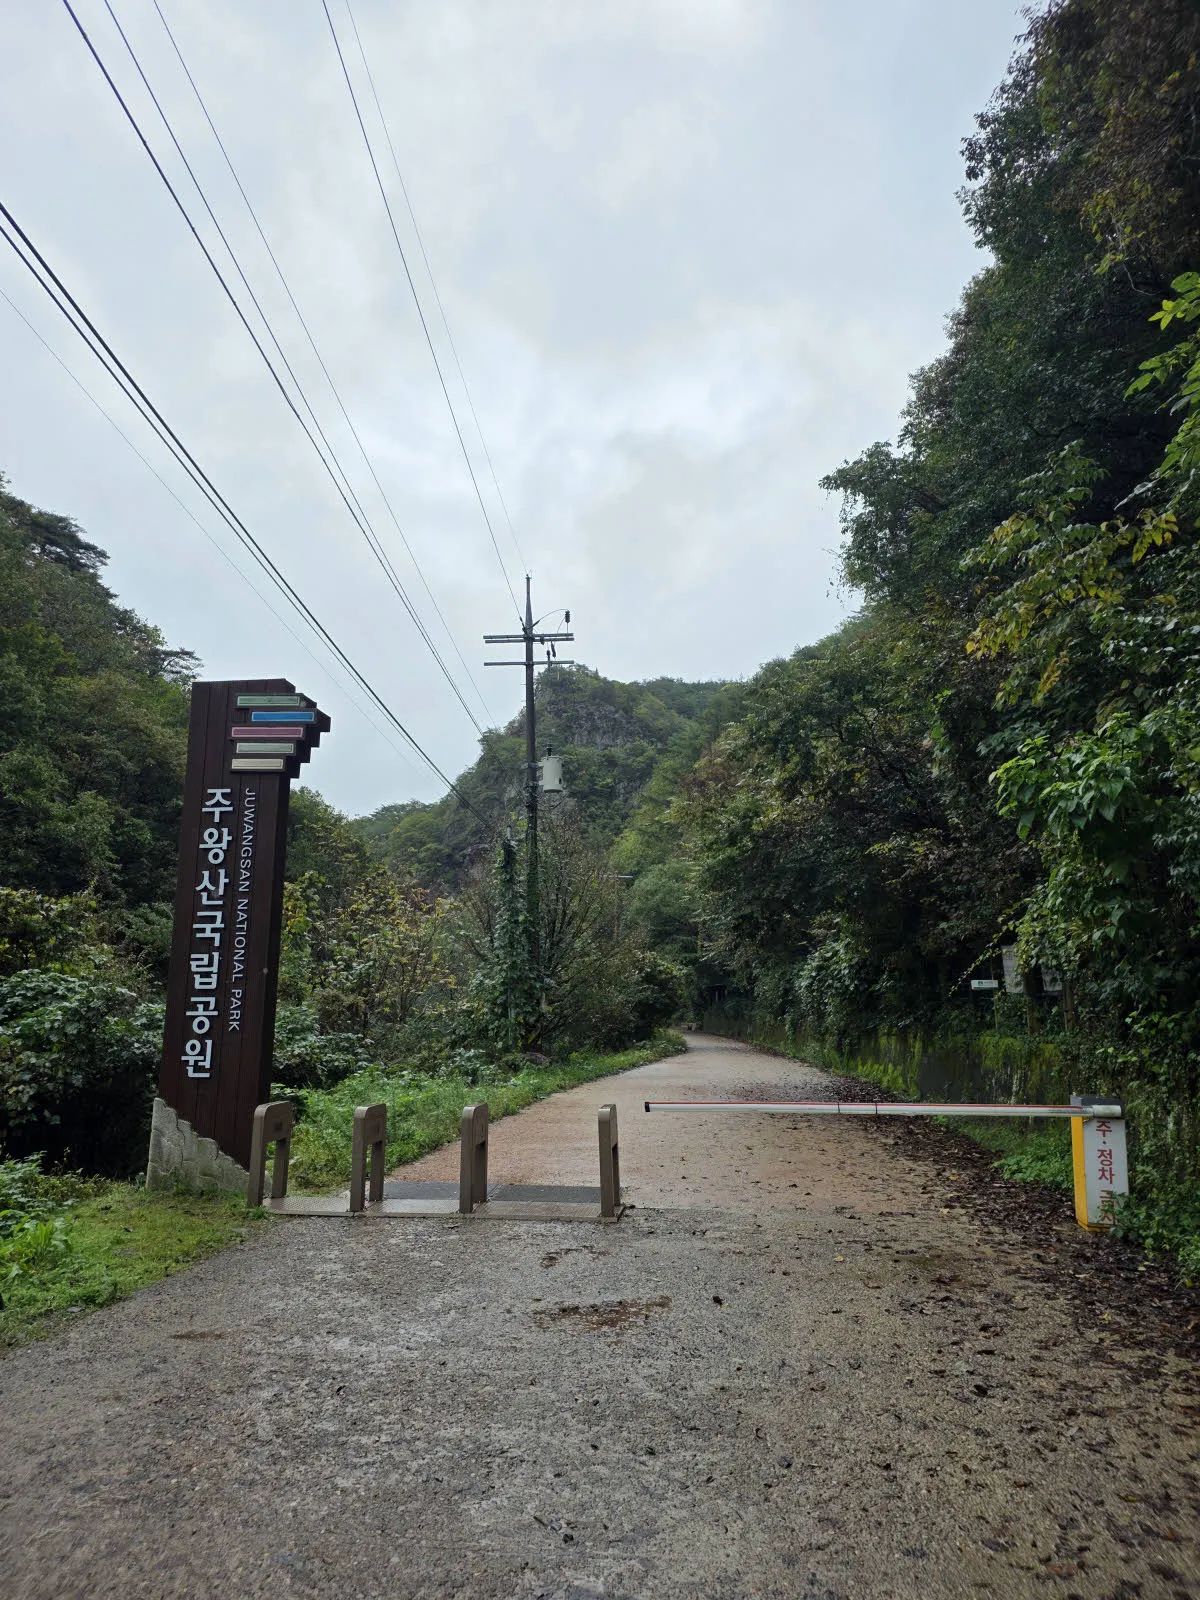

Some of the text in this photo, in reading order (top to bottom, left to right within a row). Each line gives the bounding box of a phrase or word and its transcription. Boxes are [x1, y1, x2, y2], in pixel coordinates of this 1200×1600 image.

[181, 787, 234, 1079] 주왕산국립공원
[228, 787, 256, 1033] JUWANGSAN NATIONAL PARK
